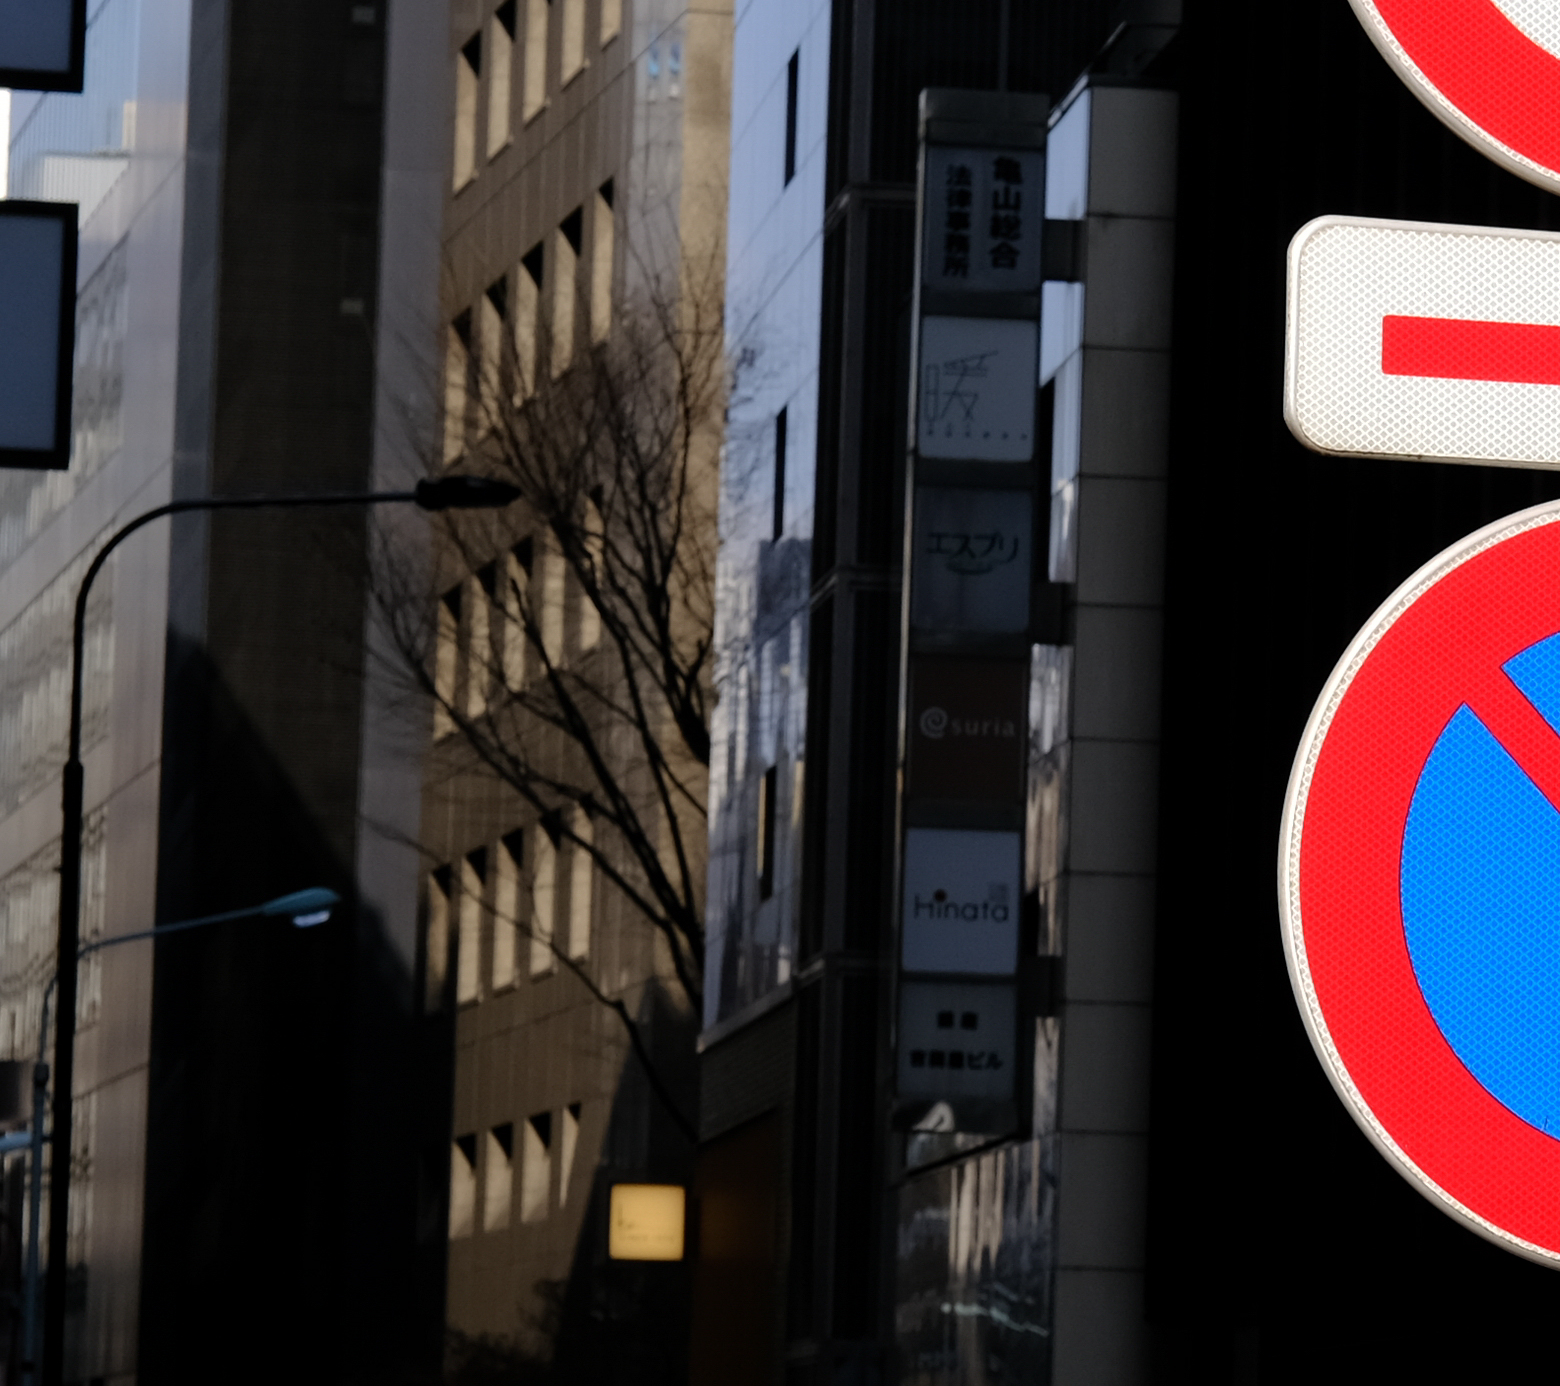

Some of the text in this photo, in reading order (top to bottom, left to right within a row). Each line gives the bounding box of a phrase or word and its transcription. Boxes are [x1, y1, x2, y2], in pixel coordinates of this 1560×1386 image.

[926, 529, 1019, 563] エスプリ
[914, 888, 1009, 923] Hinata
